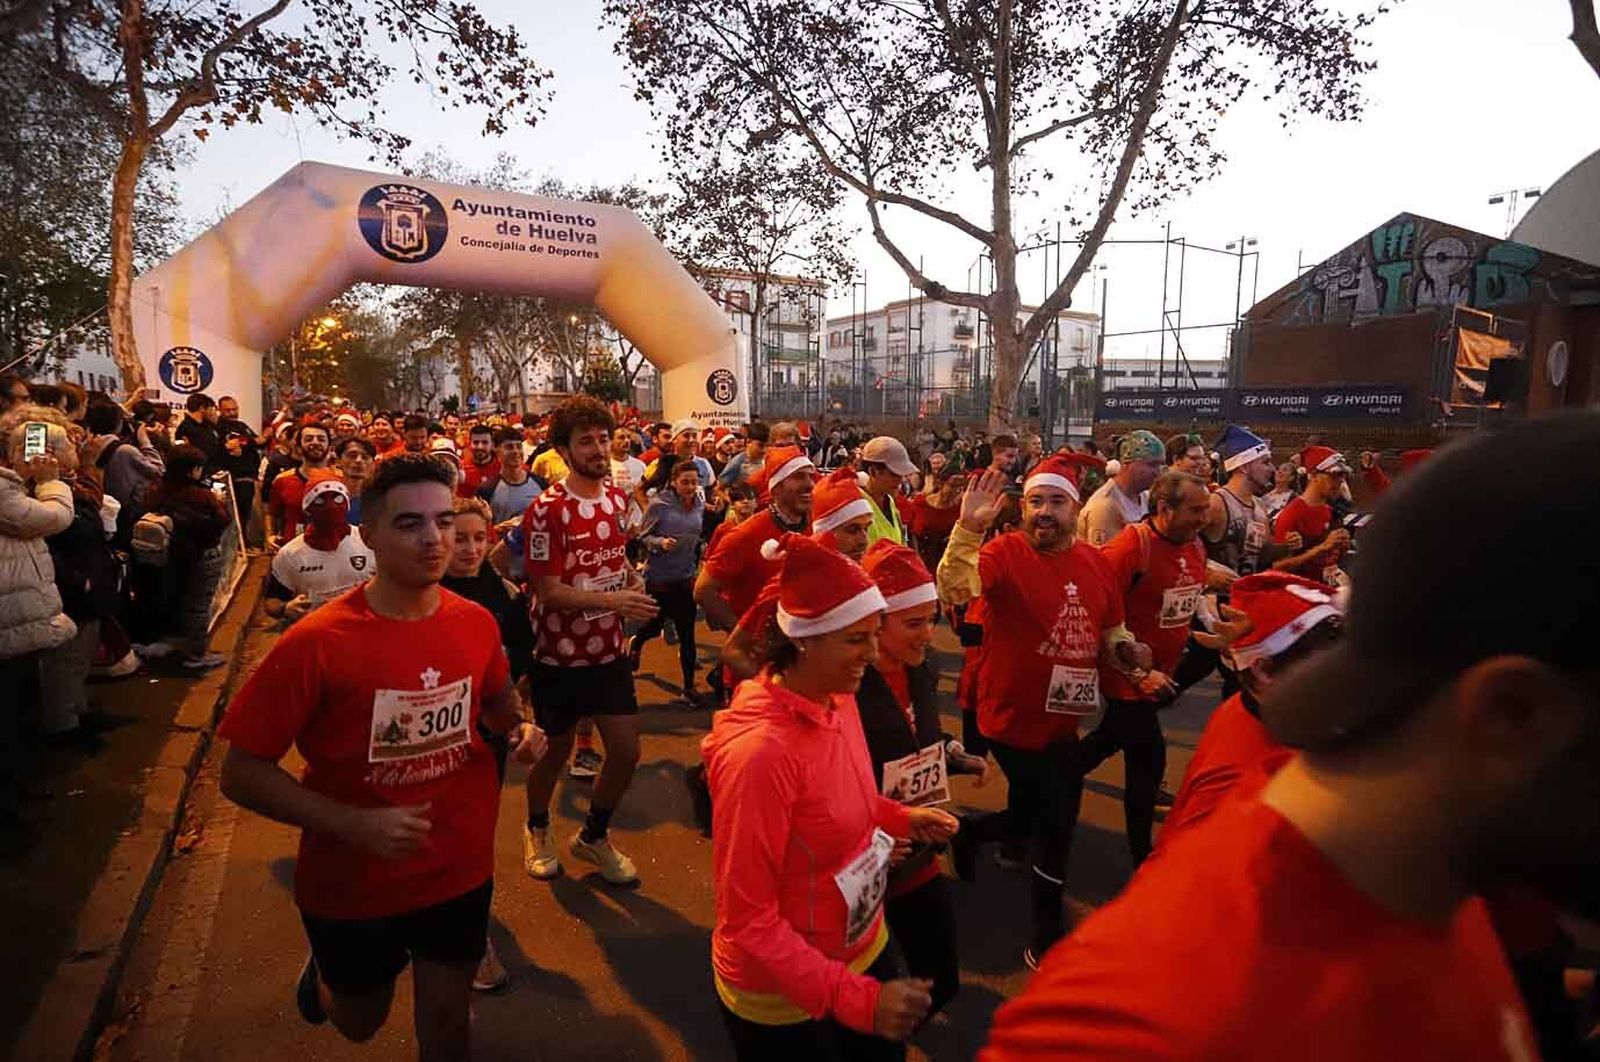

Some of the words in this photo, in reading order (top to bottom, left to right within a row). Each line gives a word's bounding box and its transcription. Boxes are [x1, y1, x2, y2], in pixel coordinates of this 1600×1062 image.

[452, 199, 596, 228] Ayuntamiento
[496, 219, 522, 237] de
[529, 224, 598, 246] Huelva
[529, 243, 545, 255] de
[547, 244, 600, 260] Deportes
[1119, 398, 1154, 407] HYUNDAI
[1180, 397, 1220, 406] HYUNDAI
[1261, 395, 1310, 406] HYUNDAI
[1345, 395, 1403, 405] HYUNDAI
[579, 547, 626, 567] Cajaso
[419, 702, 463, 737] 300
[910, 764, 941, 795] 573
